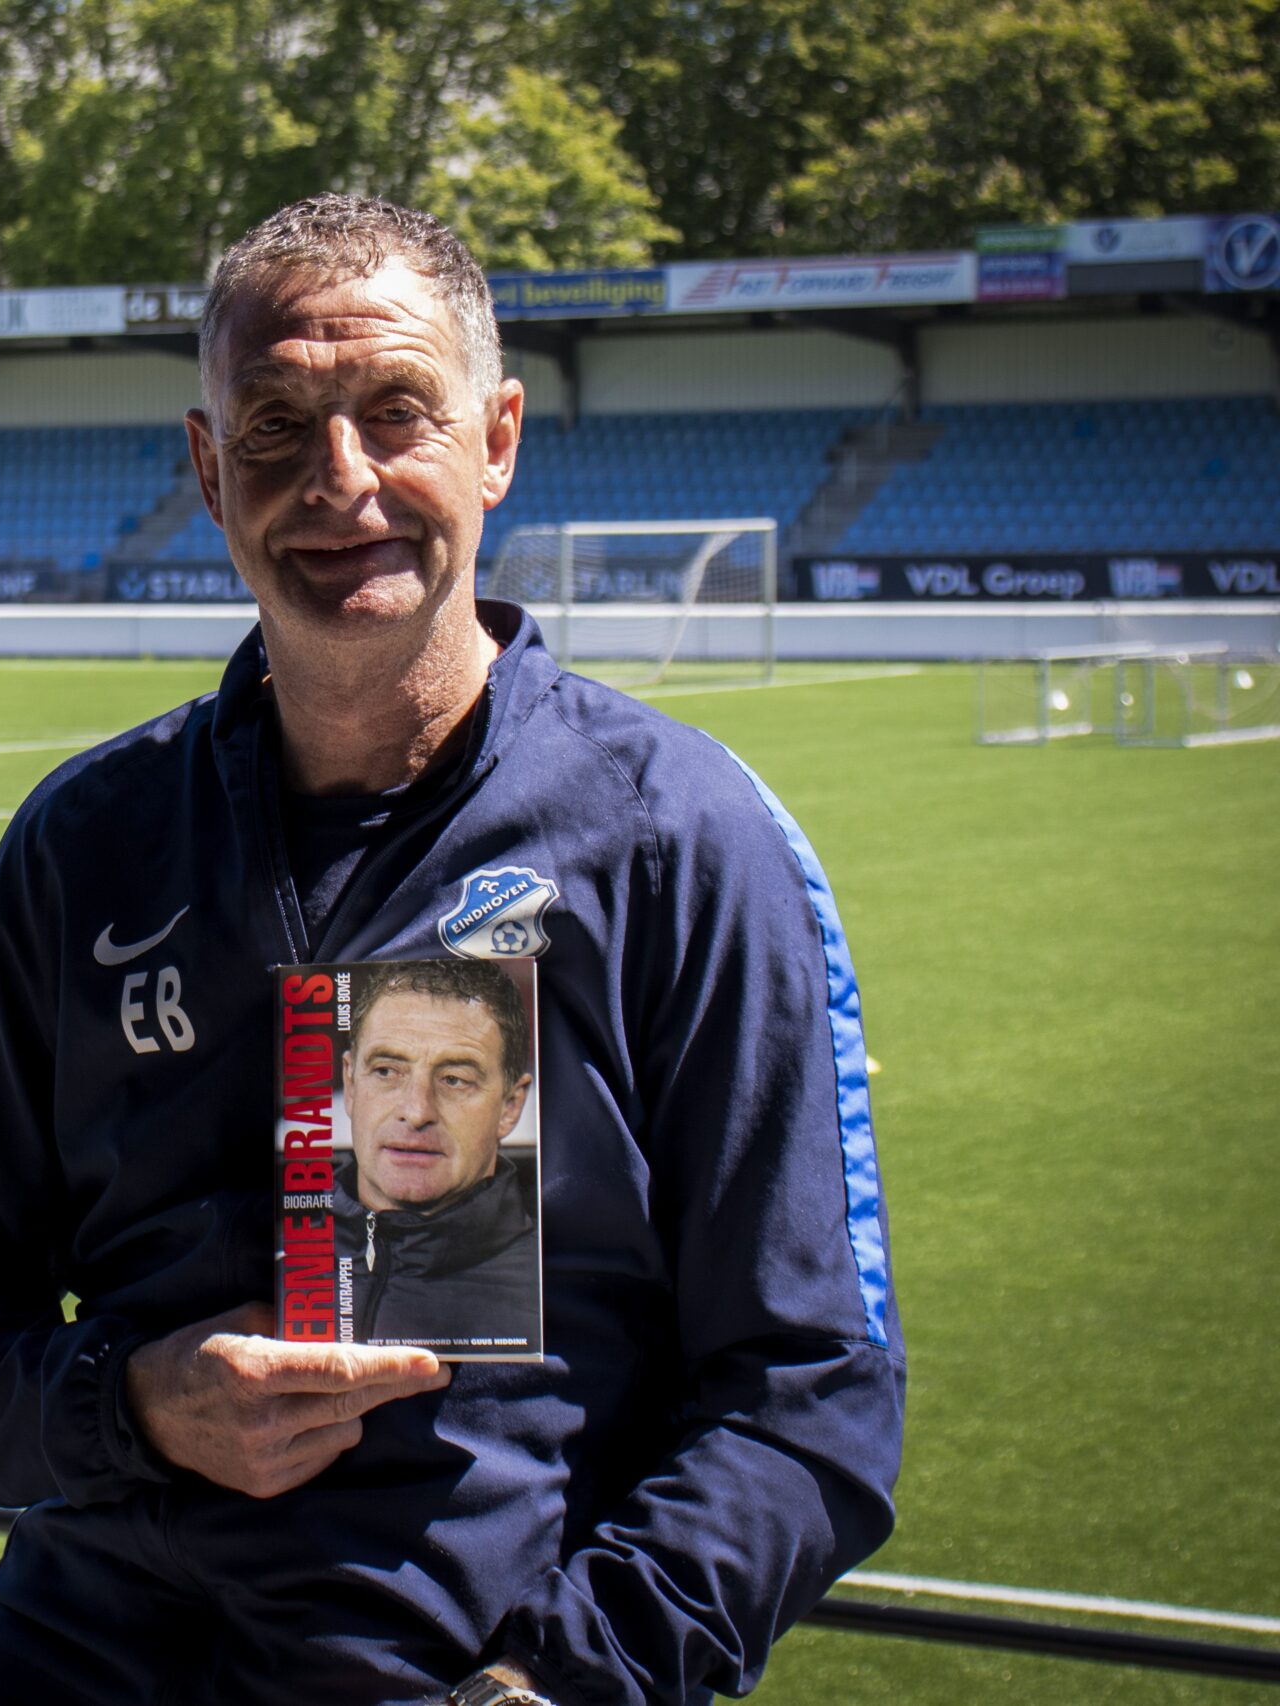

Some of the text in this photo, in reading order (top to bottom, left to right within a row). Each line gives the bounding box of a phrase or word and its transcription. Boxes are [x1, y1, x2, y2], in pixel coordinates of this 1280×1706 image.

[905, 563, 977, 595] VDL
[982, 563, 1084, 599] Groep
[450, 881, 529, 935] EINDHOVEN
[478, 880, 500, 893] FC
[121, 966, 196, 1054] EB
[335, 972, 351, 1032] LOUIS BOVÉE
[284, 973, 335, 1343] ERNIE BRANDTS
[283, 1195, 334, 1209] BIOGRAFIE
[339, 1257, 353, 1315] NATRAPPEN
[453, 1338, 470, 1346] VAN
[471, 1338, 493, 1346] GUUS
[494, 1338, 528, 1346] HIDDINK
